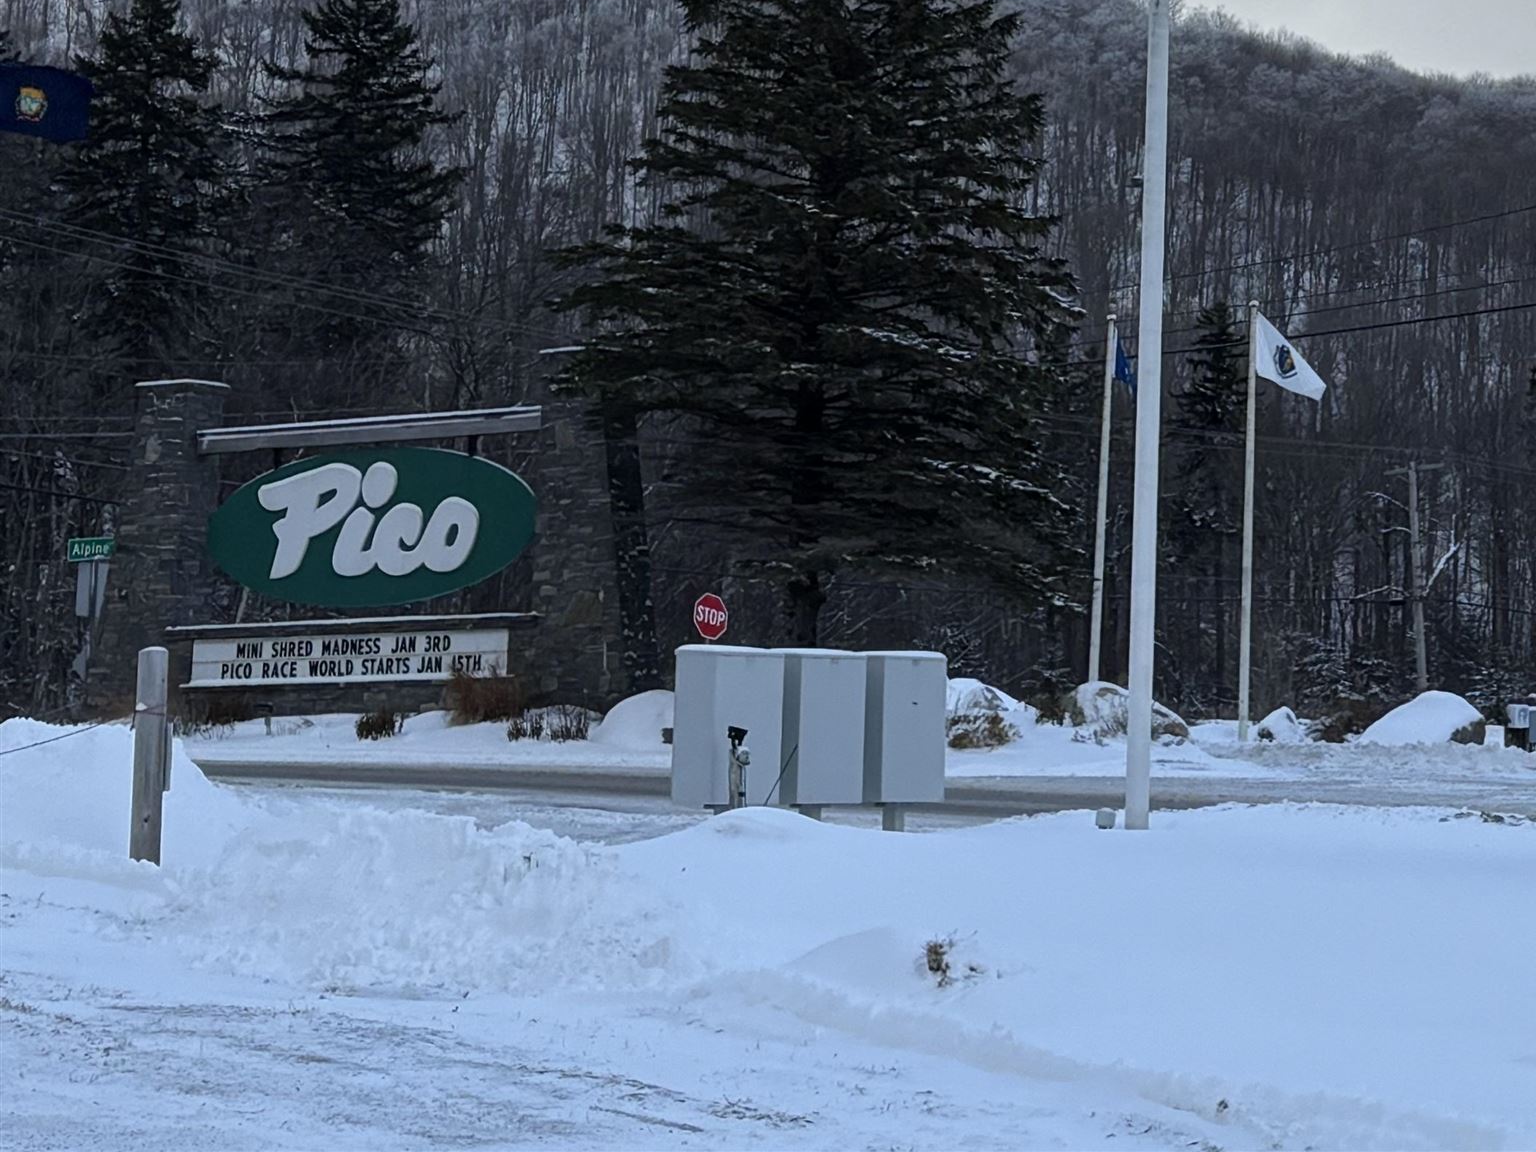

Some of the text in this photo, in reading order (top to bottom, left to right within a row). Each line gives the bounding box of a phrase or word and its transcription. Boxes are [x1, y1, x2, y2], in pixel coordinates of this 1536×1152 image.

[258, 461, 479, 579] Pico
[72, 542, 110, 557] Alpine
[696, 605, 726, 627] STOP
[236, 634, 451, 659] MINI SHRED MADNESS JAN 3RD
[220, 654, 482, 680] PICO RACE WORLD STARTS JAN 15TH
